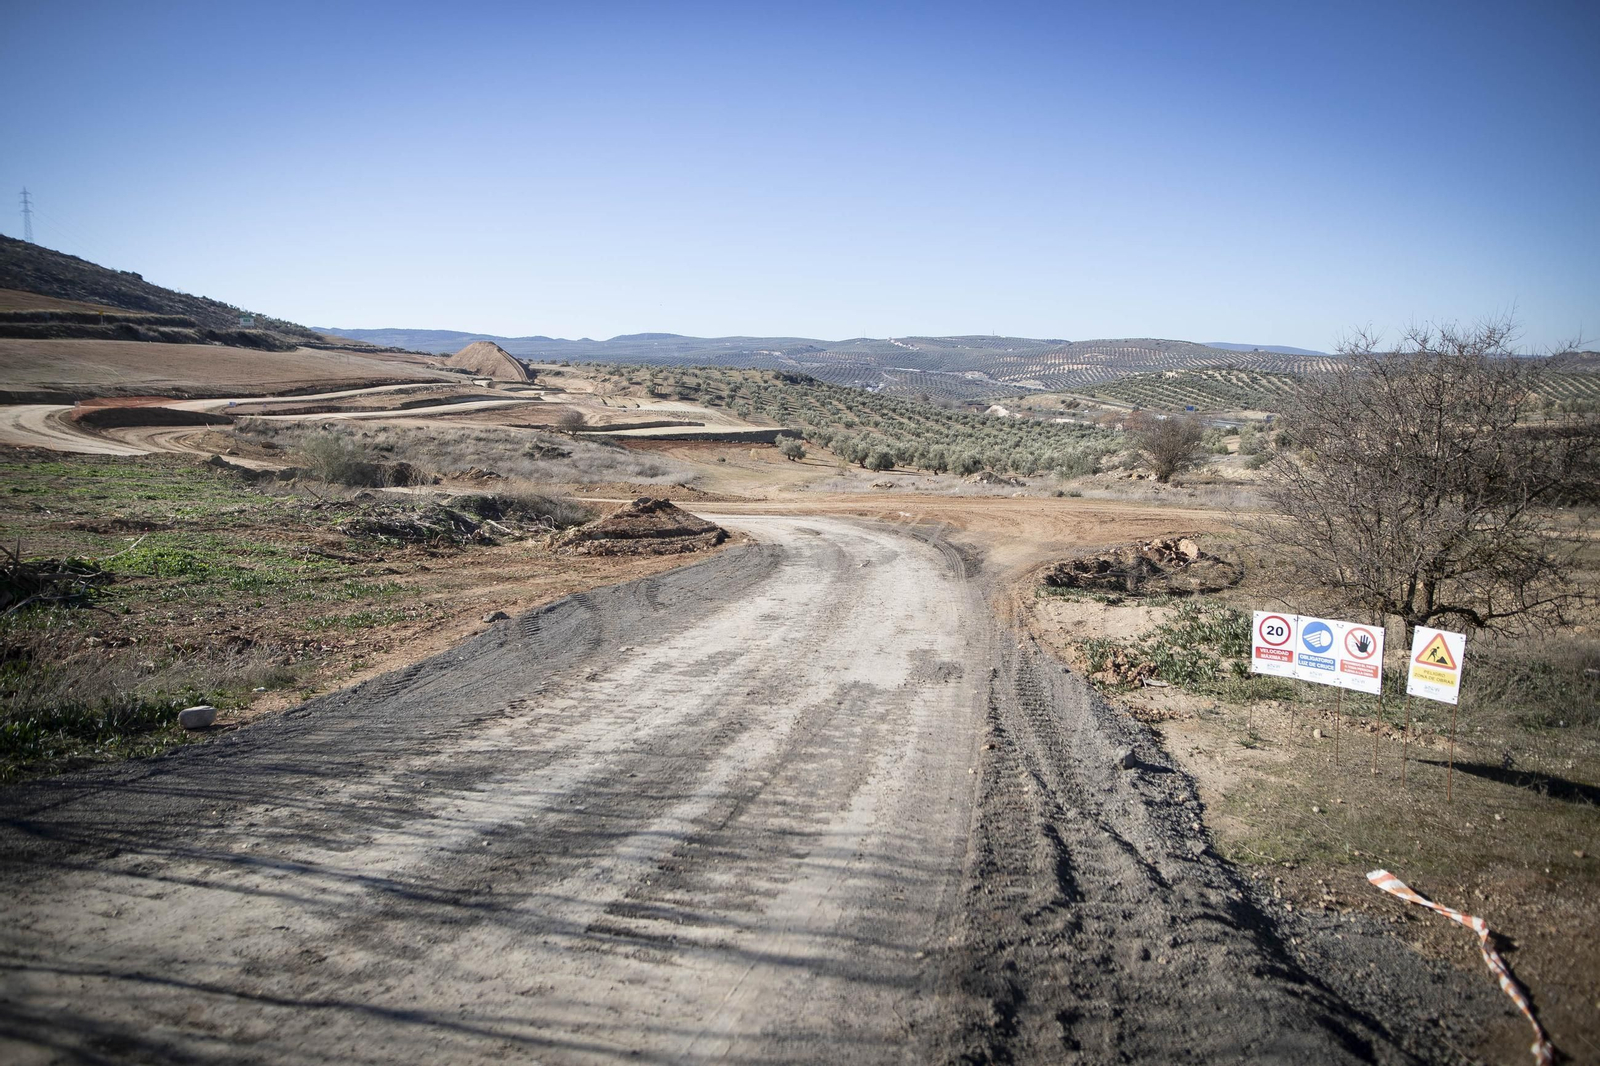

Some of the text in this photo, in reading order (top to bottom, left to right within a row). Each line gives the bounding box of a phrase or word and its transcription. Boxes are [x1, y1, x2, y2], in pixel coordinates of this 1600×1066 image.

[1266, 625, 1284, 636] 20
[1260, 648, 1290, 656] VELOCIDAD
[1300, 654, 1334, 664] OBLIGATORIO
[1436, 677, 1454, 685] OBRAS
